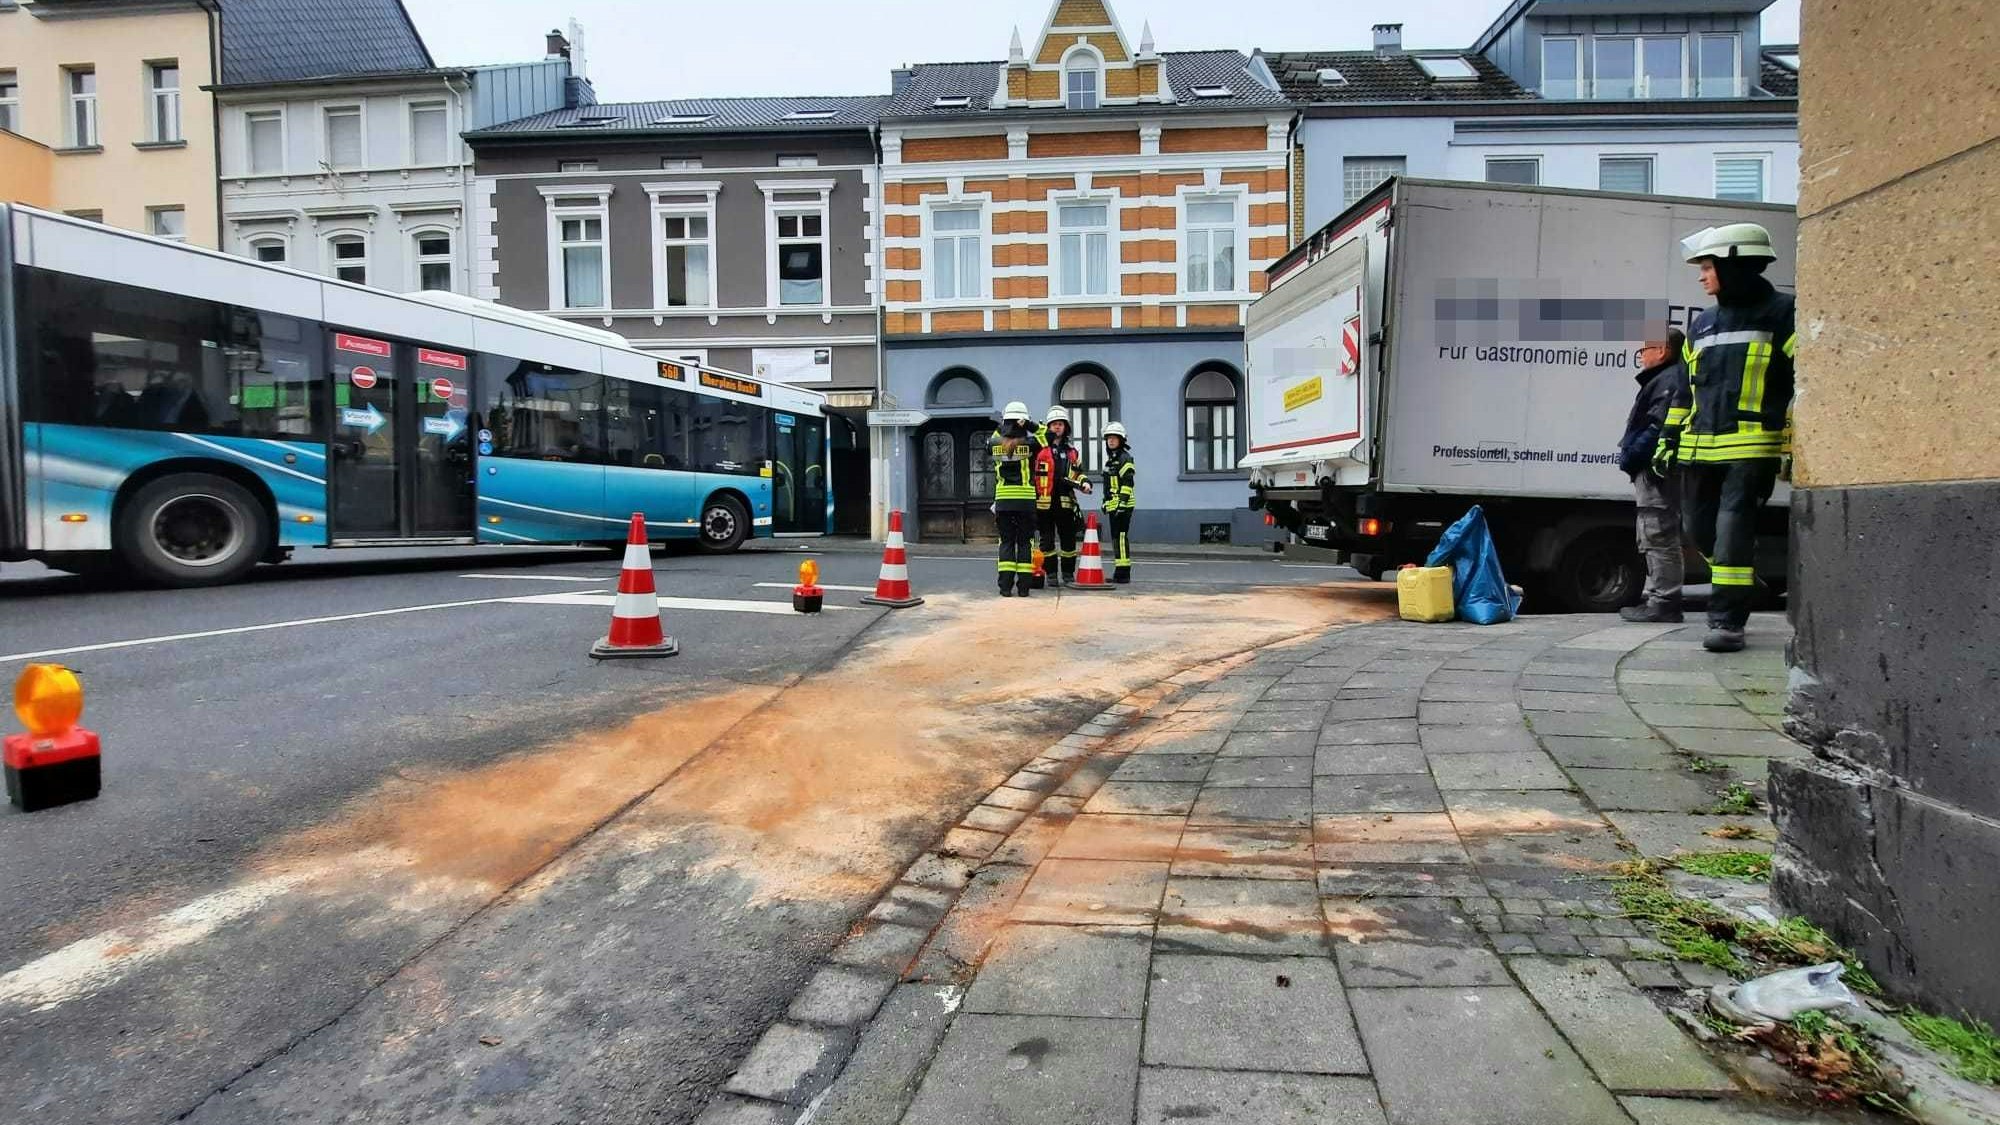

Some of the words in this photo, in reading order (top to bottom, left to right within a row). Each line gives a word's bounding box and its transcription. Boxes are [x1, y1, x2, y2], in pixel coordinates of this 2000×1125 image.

[1475, 346, 1588, 366] Gastronomie
[1595, 348, 1627, 368] und
[662, 364, 679, 379] 560
[1513, 449, 1553, 462] schnell
[1557, 451, 1578, 463] und
[1580, 452, 1621, 465] zuverlä
